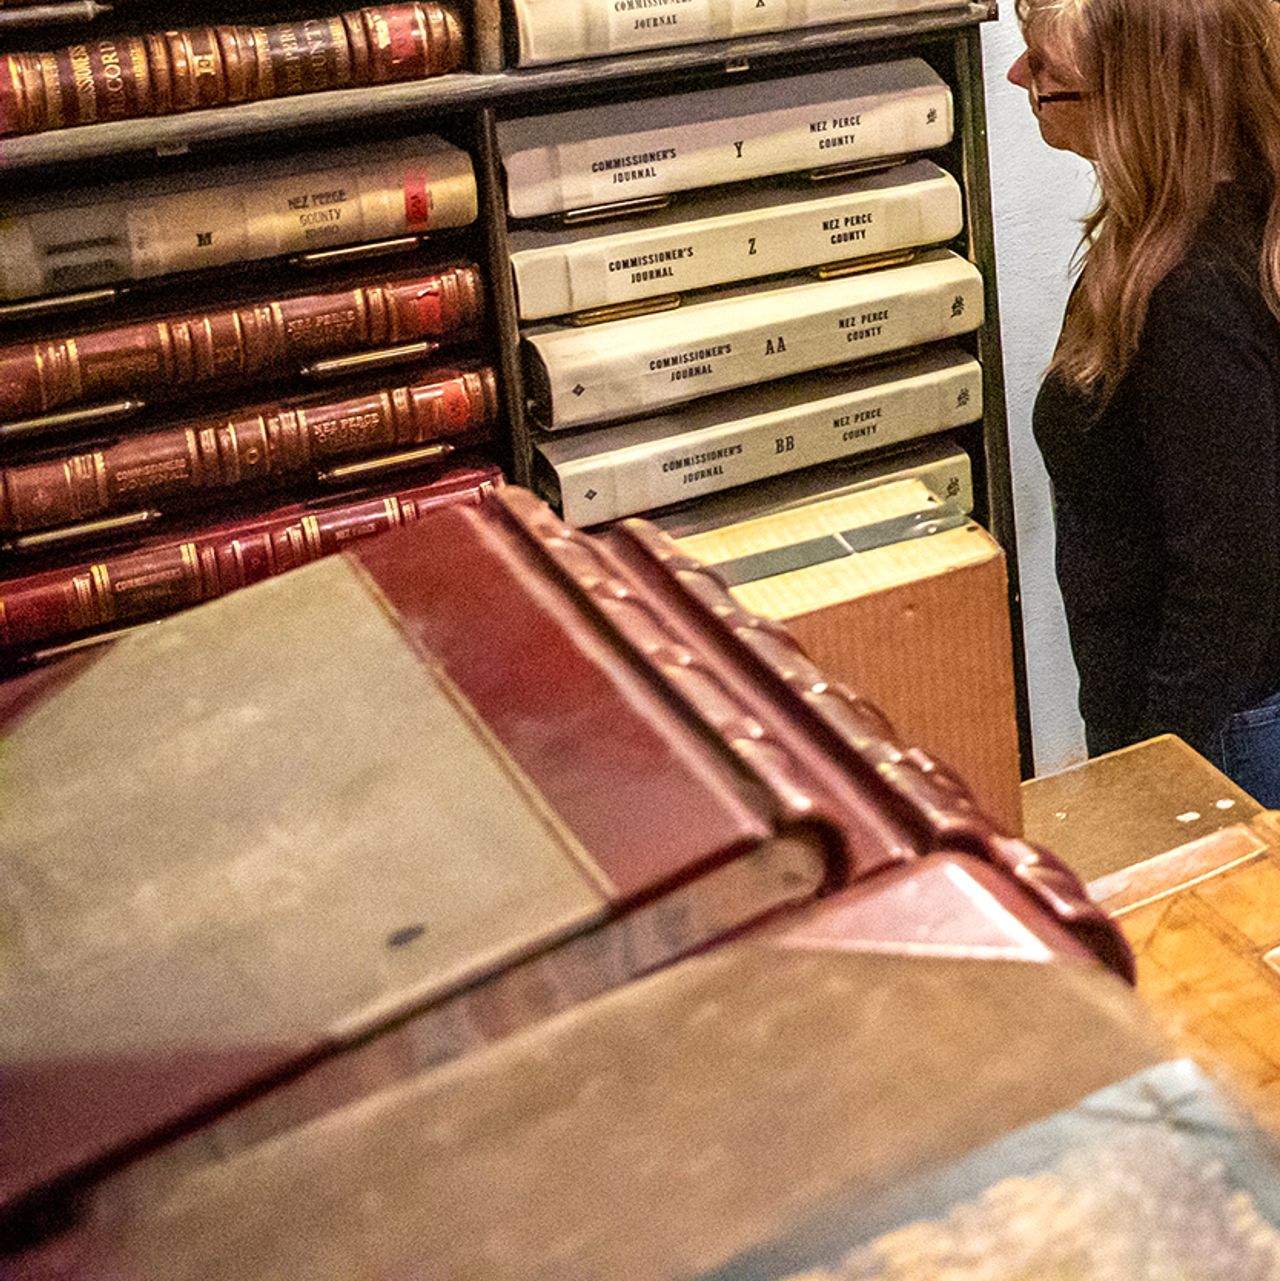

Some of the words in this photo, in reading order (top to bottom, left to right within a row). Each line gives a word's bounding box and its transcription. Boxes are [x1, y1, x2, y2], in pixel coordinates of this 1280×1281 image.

[633, 15, 678, 30] JOURNAL
[809, 120, 829, 133] NEZ
[832, 115, 862, 130] PERCE
[734, 141, 744, 158] Y
[819, 133, 855, 150] COUNTY
[591, 148, 677, 173] COMMISSIONER'S
[612, 166, 658, 184] JOURNAL
[287, 196, 309, 210] NEZ
[312, 190, 347, 205] PERCE
[300, 208, 342, 226] COUNTY
[822, 217, 841, 230] NEZ
[844, 212, 873, 227] PERCE
[830, 228, 866, 245] COUNTY
[748, 239, 757, 255] Z
[608, 246, 694, 272] COMMISSIONER'S
[630, 266, 674, 283] JOURNAL
[838, 315, 856, 328] NEZ
[861, 309, 889, 324] PERCE
[846, 325, 882, 342] COUNTY
[765, 337, 786, 355] AA
[649, 343, 733, 370] COMMISSIONER'S
[671, 364, 713, 381] JOURNAL
[833, 415, 851, 428] NEZ
[854, 408, 882, 424] PERCE
[842, 423, 878, 441] COUNTY
[775, 436, 795, 454] BB
[662, 444, 743, 472] COMMISSIONER'S
[682, 465, 725, 484] JOURNAL
